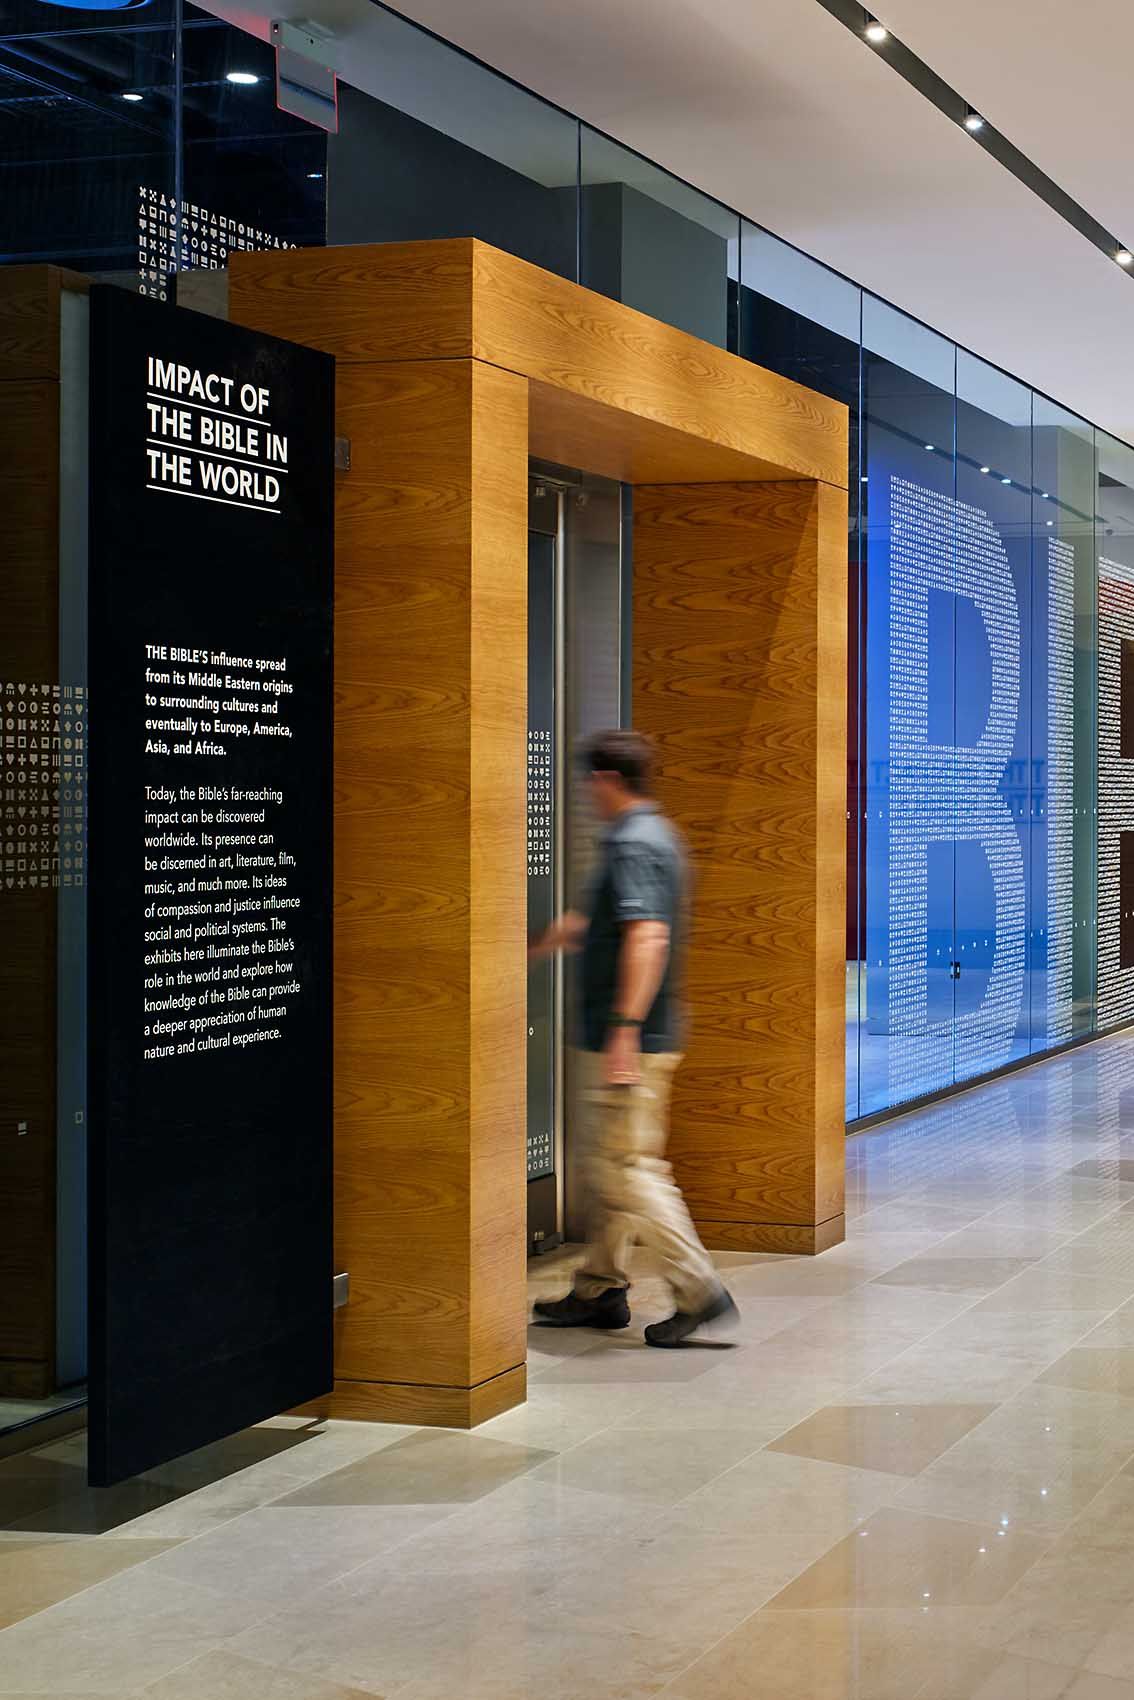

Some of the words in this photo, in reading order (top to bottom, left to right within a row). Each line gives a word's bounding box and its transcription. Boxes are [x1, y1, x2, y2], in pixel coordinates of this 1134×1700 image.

[148, 356, 234, 406] IMPACT
[240, 383, 270, 415] OF
[146, 402, 193, 442] THE
[200, 415, 259, 457] BIBLE
[266, 432, 288, 464] IN
[146, 448, 192, 486] THE
[199, 459, 280, 503] WORLD
[145, 644, 167, 660] THE
[170, 648, 209, 664] BIBLE'S
[211, 651, 253, 668] influence
[255, 658, 287, 673] spread
[145, 668, 170, 684] from
[172, 670, 186, 685] its
[188, 672, 223, 688] Middle
[225, 676, 261, 691] Eastern
[262, 680, 294, 696] origins
[145, 693, 157, 706] to
[159, 696, 220, 714] surrounding
[222, 698, 259, 713] cultures
[261, 701, 278, 714] and
[145, 717, 198, 735] eventually
[200, 720, 212, 732] to
[214, 720, 251, 737] Europe,
[253, 722, 293, 738] America,
[145, 739, 171, 755] Asia,
[173, 740, 192, 754] and
[195, 741, 227, 756] Africa.
[144, 786, 177, 805] Today,
[179, 786, 195, 800] the
[198, 787, 229, 801] Bible's
[230, 786, 283, 805] far-reaching
[145, 810, 179, 828] impact
[181, 812, 198, 824] can
[201, 809, 213, 823] be
[216, 809, 265, 823] discovered
[145, 832, 199, 847] worldwide.
[201, 832, 213, 846] Its
[215, 834, 256, 850] presence
[258, 833, 274, 845] can
[145, 856, 158, 871] be
[160, 854, 206, 870] discerned
[208, 855, 217, 868] in
[219, 856, 234, 870] art,
[236, 853, 277, 868] literature,
[278, 852, 297, 868] film,
[145, 881, 175, 895] music,
[177, 877, 196, 893] and
[198, 876, 223, 891] much
[225, 878, 250, 889] more.
[253, 875, 263, 888] Its
[265, 874, 287, 888] ideas
[144, 903, 156, 918] of
[157, 901, 212, 920] compassion
[214, 899, 232, 913] and
[233, 897, 262, 915] justice
[263, 895, 301, 910] influence
[144, 925, 172, 942] social
[174, 924, 192, 939] and
[194, 921, 230, 942] political
[231, 922, 268, 938] systems.
[271, 917, 287, 930] The
[144, 949, 182, 965] exhibits
[184, 947, 205, 961] here
[207, 944, 250, 959] illuminate
[251, 940, 266, 954] the
[268, 938, 295, 953] Bible's
[144, 973, 164, 989] role
[165, 973, 175, 986] in
[177, 970, 192, 986] the
[194, 966, 221, 983] world
[222, 964, 239, 980] and
[241, 963, 274, 981] explore
[275, 960, 293, 973] how
[144, 993, 196, 1012] knowledge
[198, 990, 208, 1006] of
[210, 990, 225, 1003] the
[227, 986, 250, 1001] Bible
[252, 986, 267, 999] can
[269, 980, 301, 1000] provide
[144, 1025, 150, 1036] a
[152, 1018, 188, 1037] deeper
[189, 1010, 245, 1033] appreciation
[247, 1006, 258, 1021] of
[258, 1005, 287, 1019] human
[144, 1044, 175, 1059] nature
[177, 1037, 195, 1054] and
[197, 1032, 231, 1051] cultural
[232, 1028, 282, 1048] experience.
